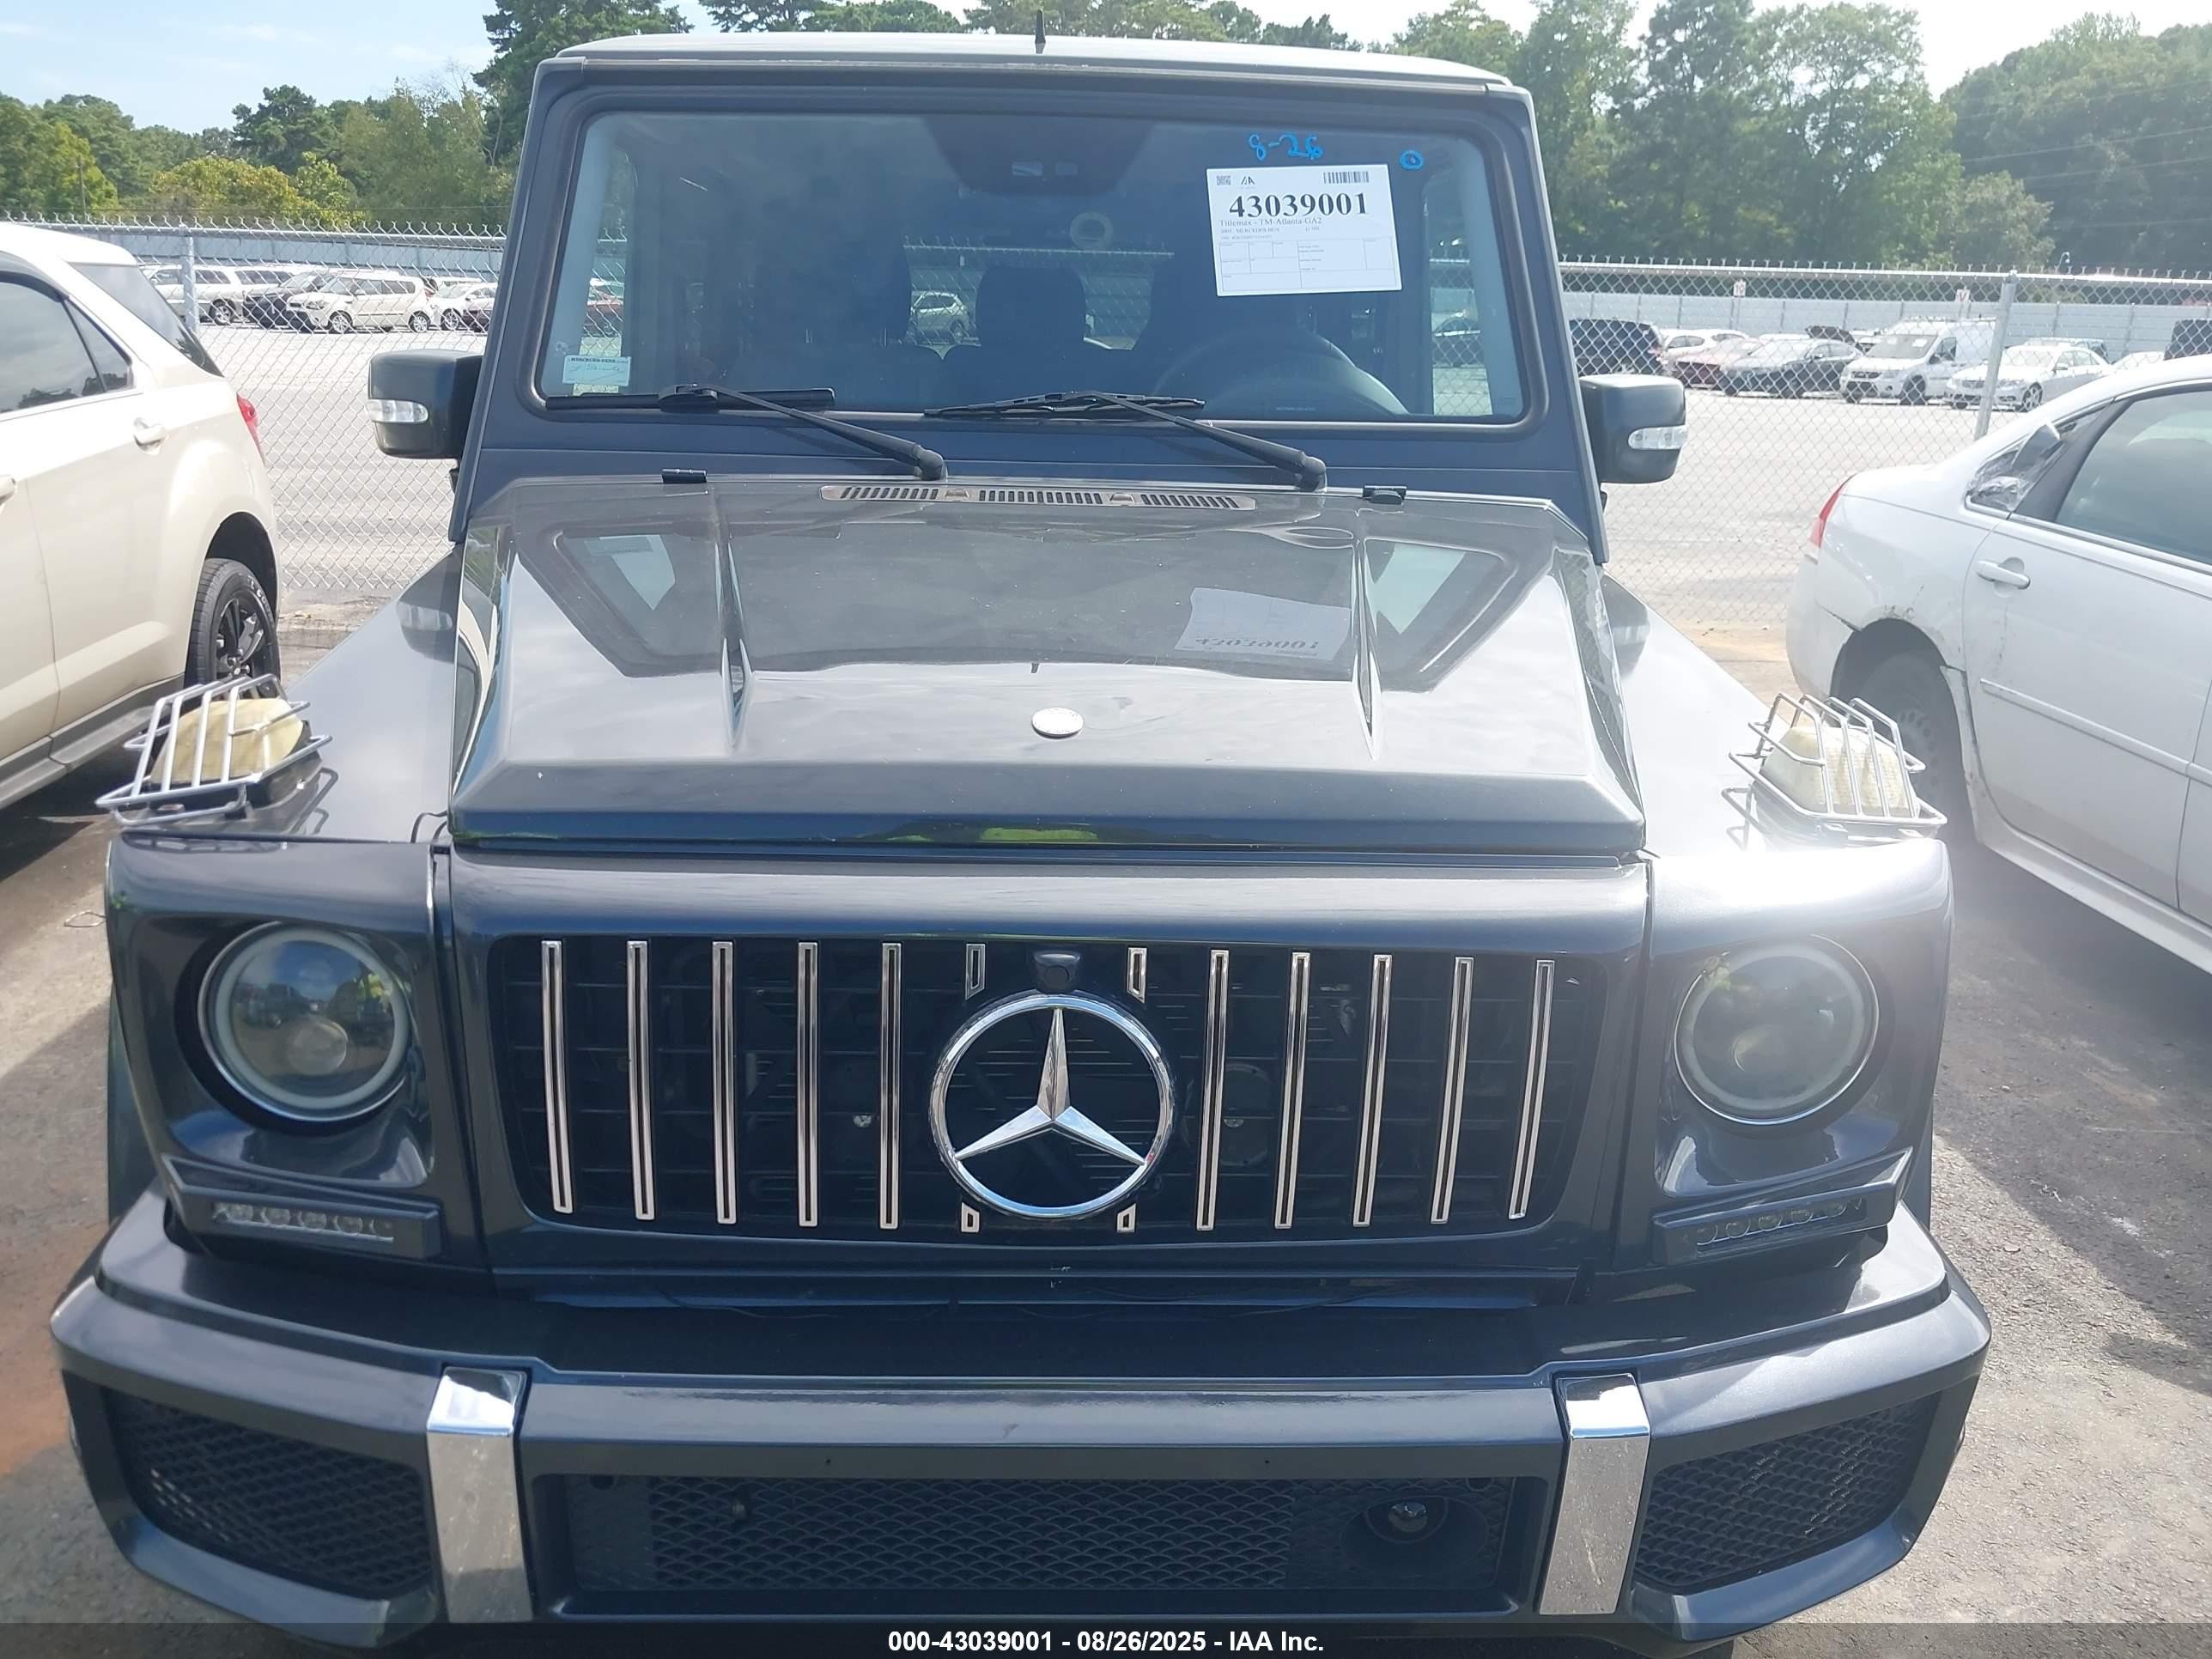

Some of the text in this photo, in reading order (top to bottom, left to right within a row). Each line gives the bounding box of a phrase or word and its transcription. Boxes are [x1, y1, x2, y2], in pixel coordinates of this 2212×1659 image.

[1229, 191, 1369, 218] 43039001
[1220, 219, 1253, 228] Titlemax
[1260, 217, 1322, 227] TM-Atlanta-GA2
